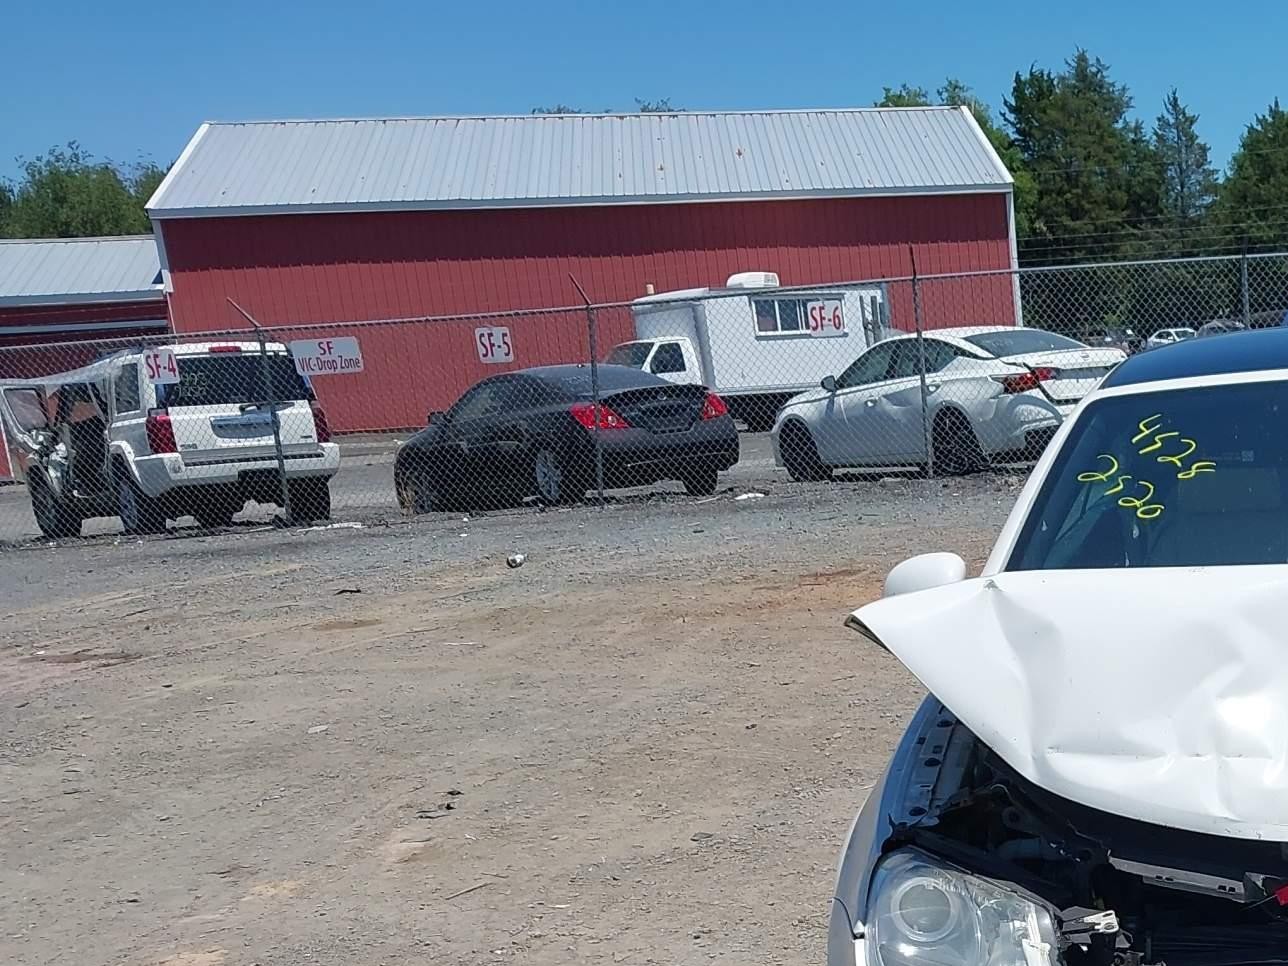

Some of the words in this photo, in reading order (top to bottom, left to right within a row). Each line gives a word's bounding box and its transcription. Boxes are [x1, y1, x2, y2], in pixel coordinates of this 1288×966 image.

[810, 306, 842, 331] SF-6
[318, 341, 334, 355] SF
[479, 332, 511, 357] SF-5
[145, 351, 177, 379] SF-4
[298, 356, 337, 372] VIC-Drop
[338, 354, 361, 369] Zone
[1131, 413, 1217, 479] 4528
[1077, 455, 1165, 518] 2520
